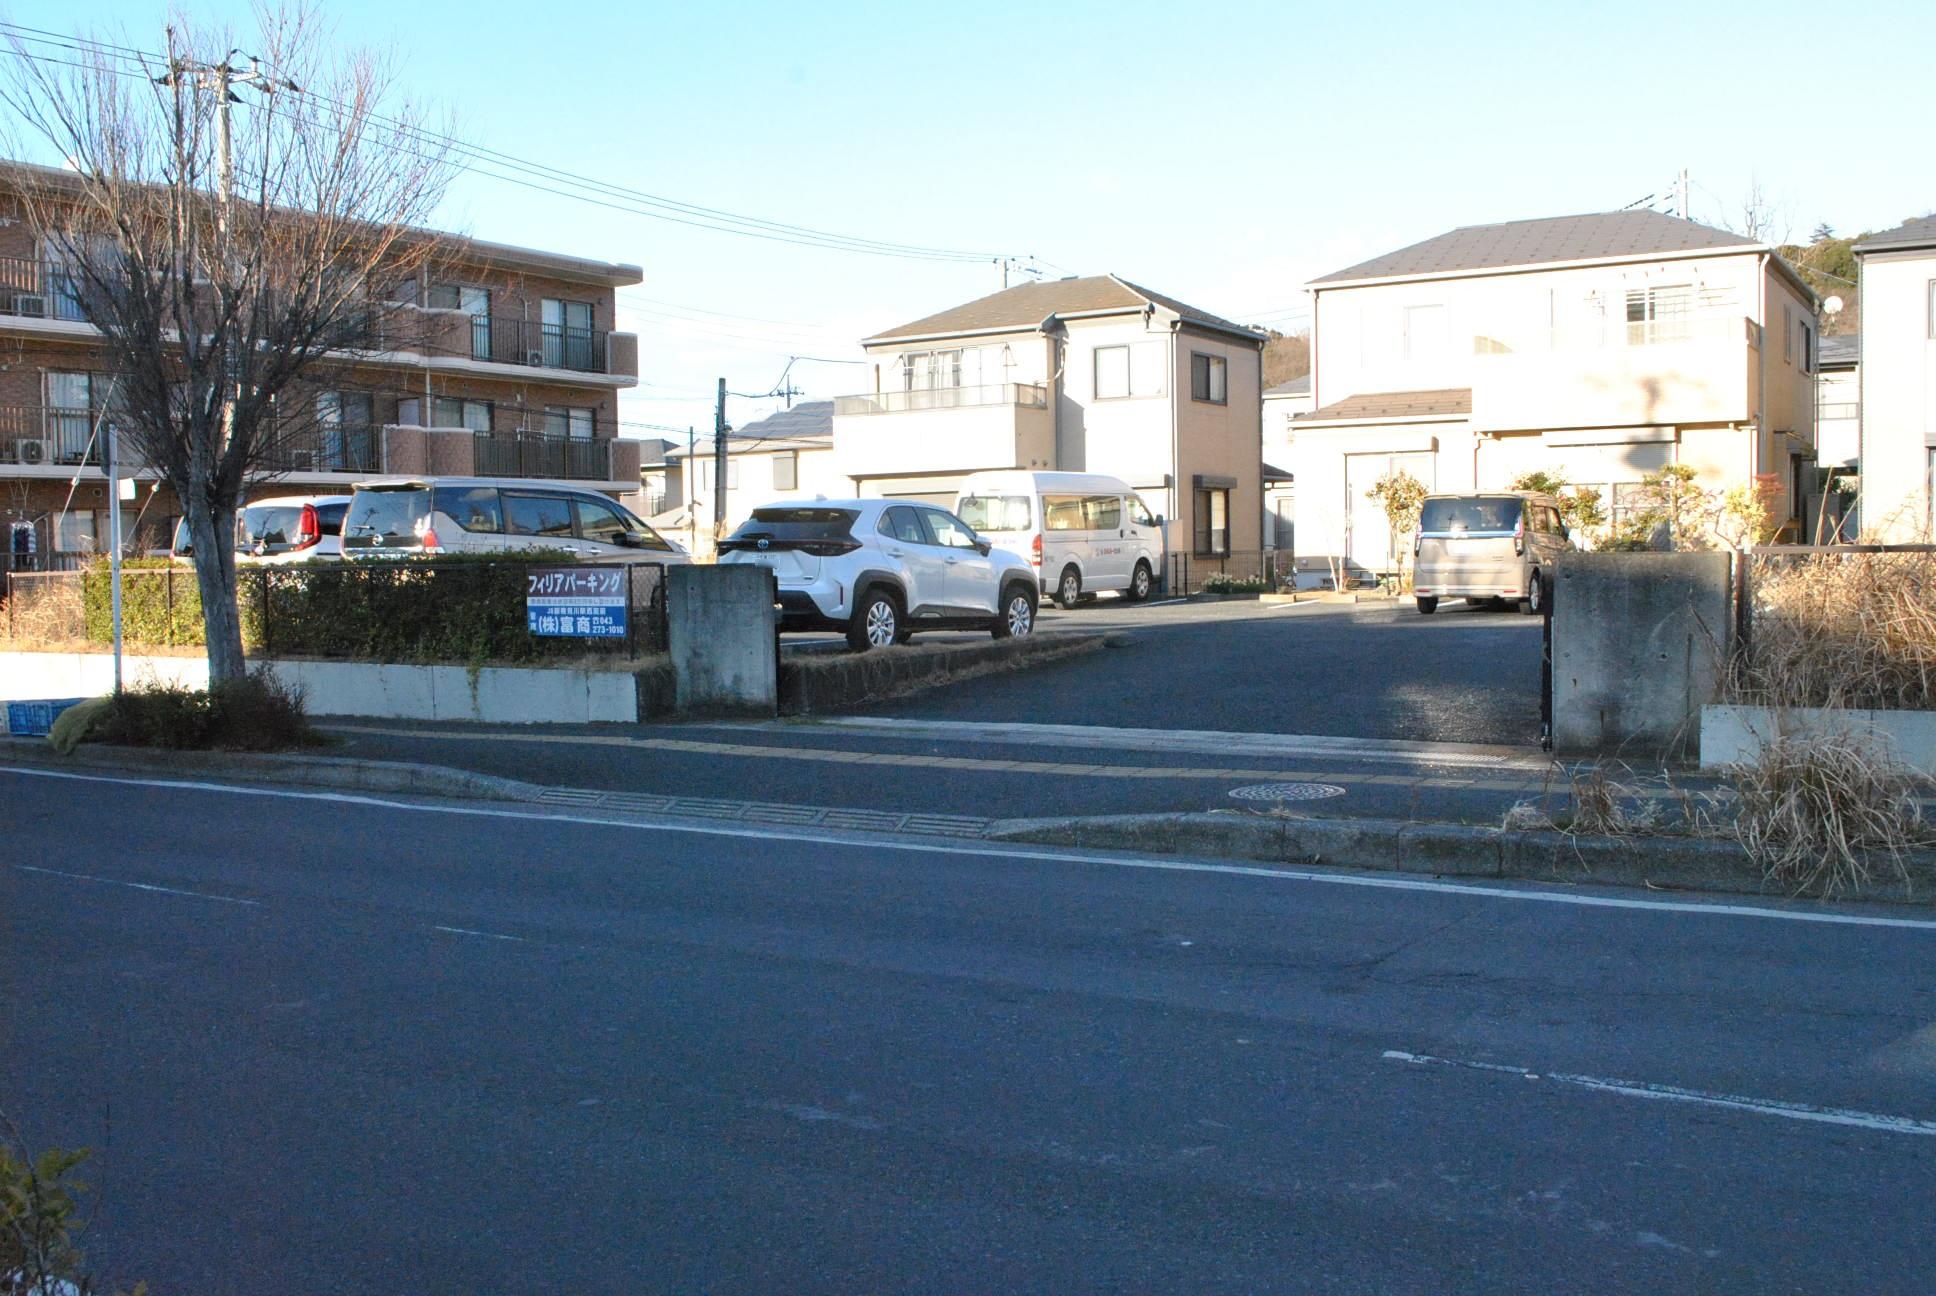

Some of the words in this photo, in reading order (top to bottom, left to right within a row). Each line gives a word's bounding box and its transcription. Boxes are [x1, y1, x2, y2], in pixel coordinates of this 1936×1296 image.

[528, 571, 622, 594] フィリアパーキング
